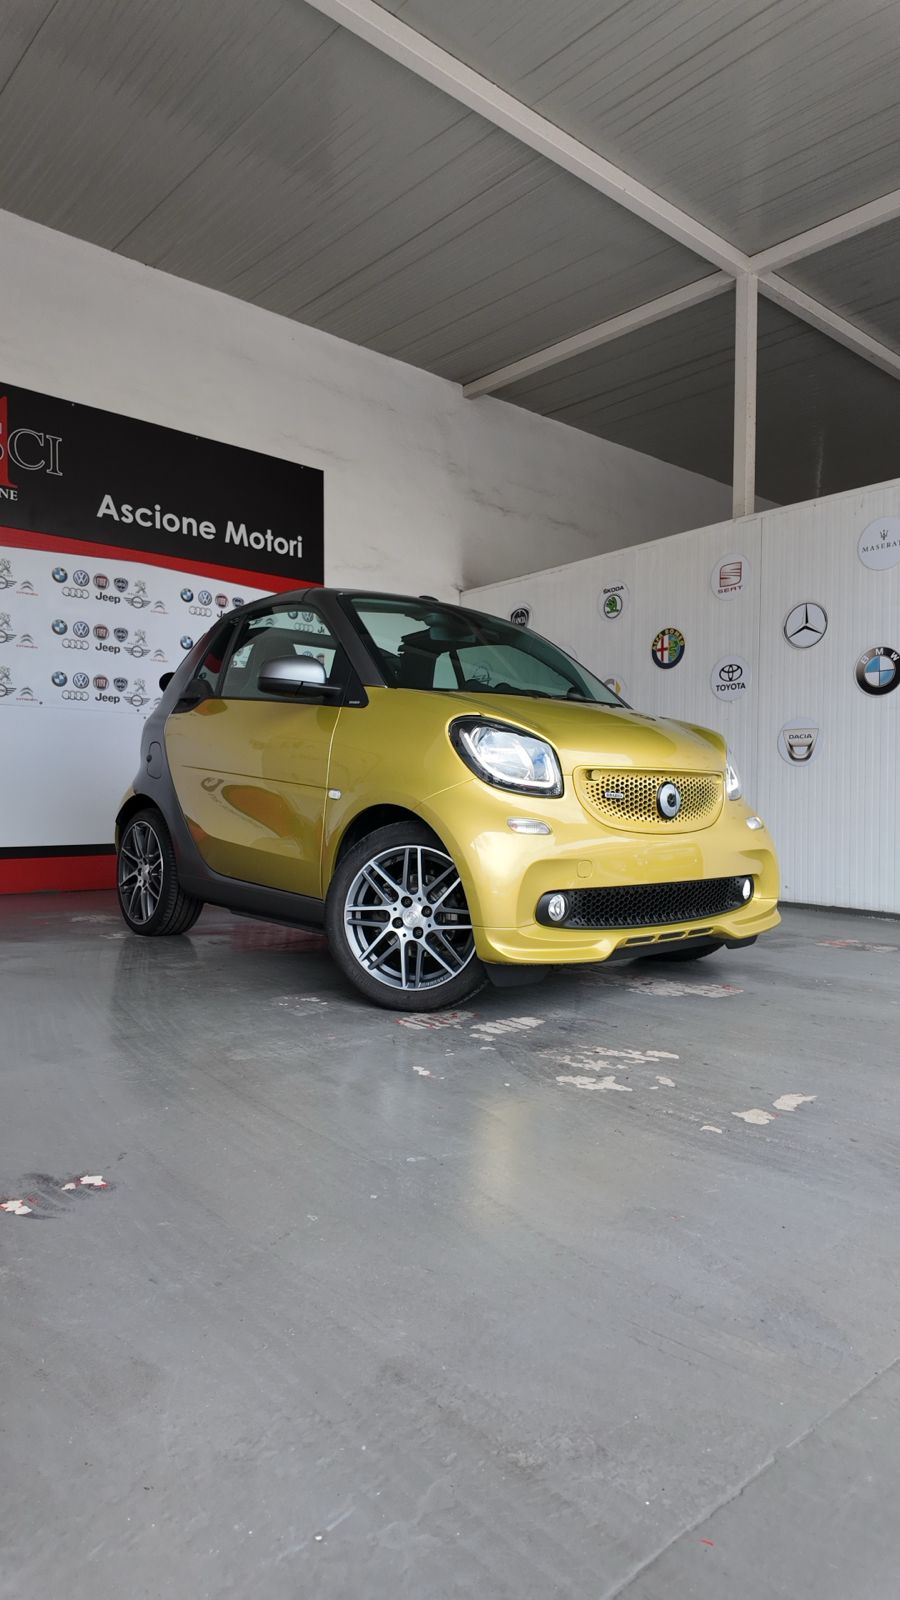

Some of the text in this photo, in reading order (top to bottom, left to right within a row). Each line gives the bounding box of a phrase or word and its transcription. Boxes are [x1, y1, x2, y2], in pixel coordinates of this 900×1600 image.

[0, 421, 63, 476] CI
[96, 494, 303, 559] Ascione Motori
[717, 585, 743, 594] SEAT
[95, 592, 121, 604] Jeep
[95, 642, 121, 654] Jeep
[861, 648, 900, 665] BMW
[715, 682, 746, 692] TOYOTA
[95, 693, 121, 704] Jeep
